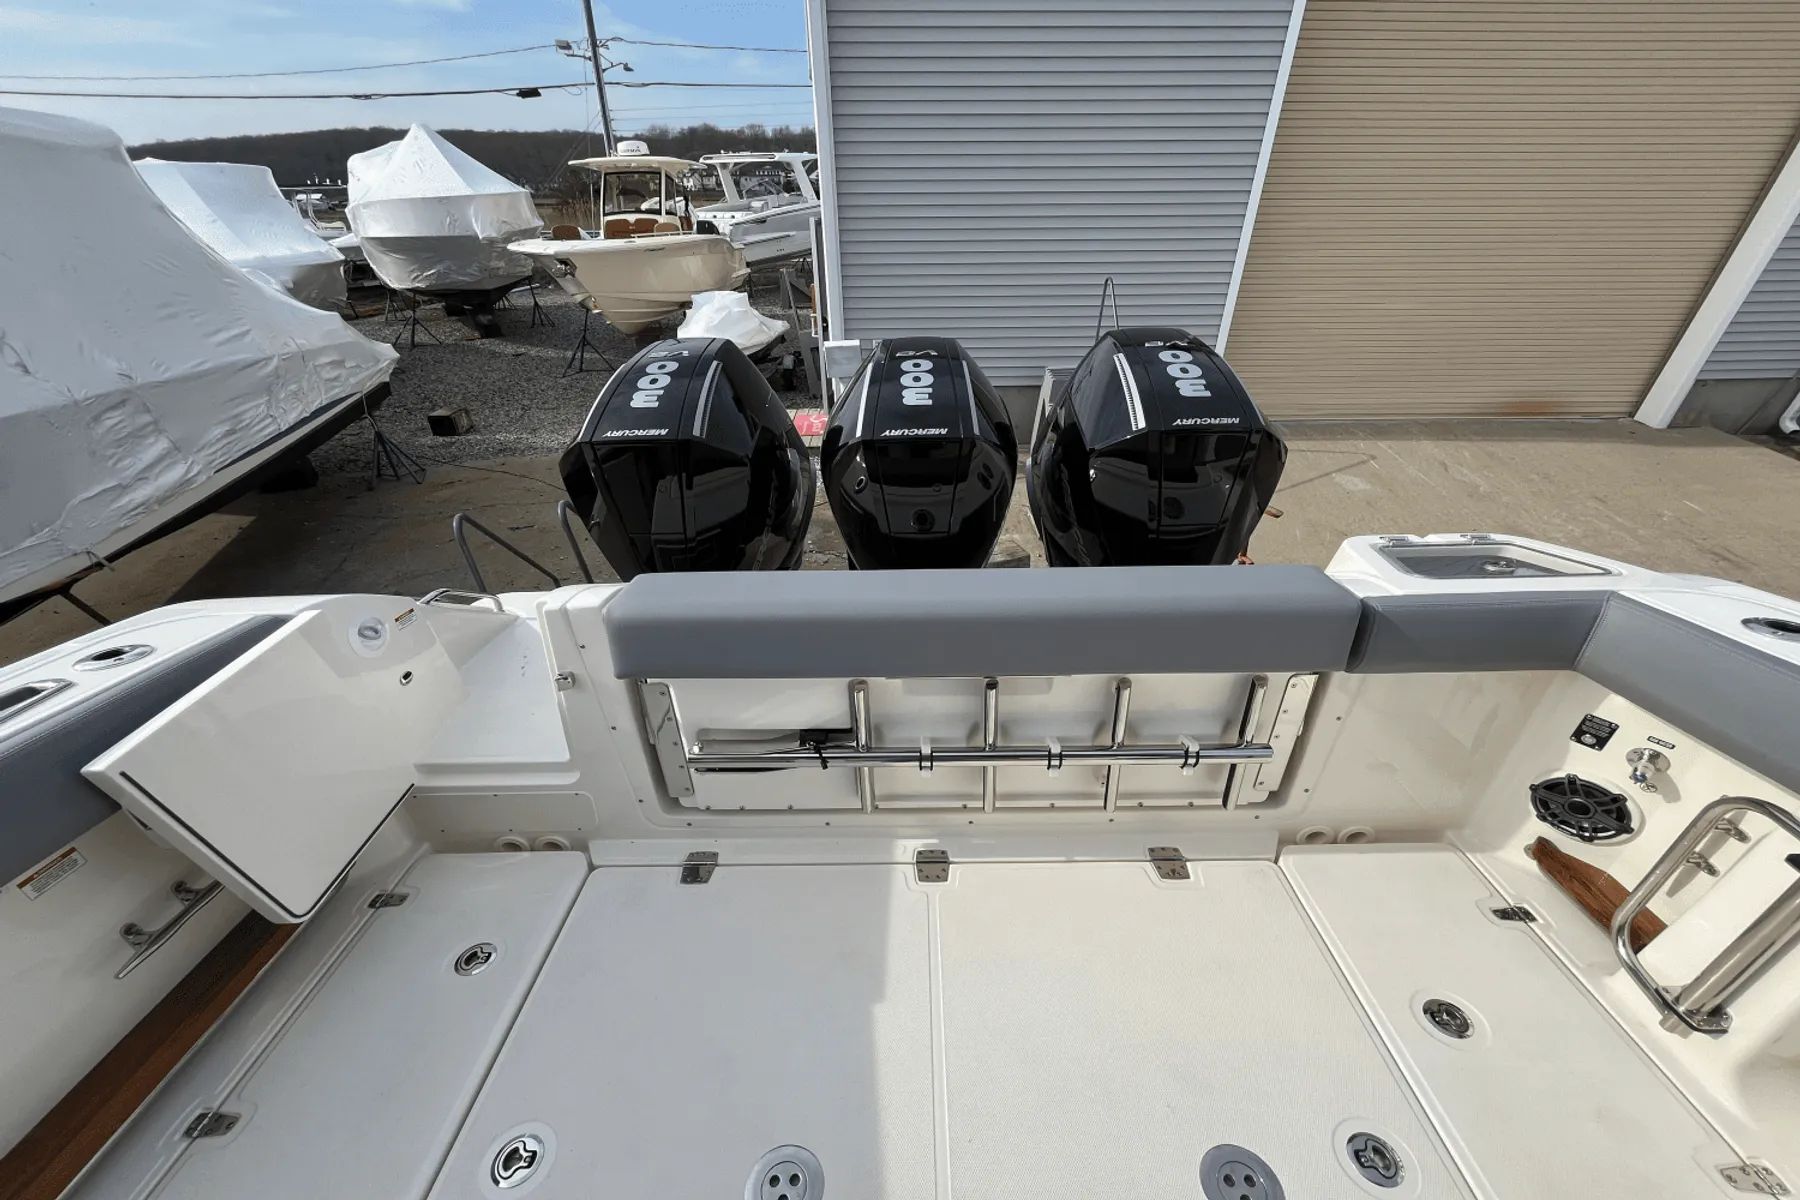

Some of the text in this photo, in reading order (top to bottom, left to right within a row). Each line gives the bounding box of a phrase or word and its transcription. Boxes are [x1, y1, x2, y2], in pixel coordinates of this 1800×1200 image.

[630, 361, 679, 408] 300
[900, 359, 935, 406] 300
[1158, 350, 1212, 398] 300
[602, 428, 669, 438] MERCURY
[880, 428, 948, 437] MERCURY
[1172, 417, 1240, 426] MERCURY
